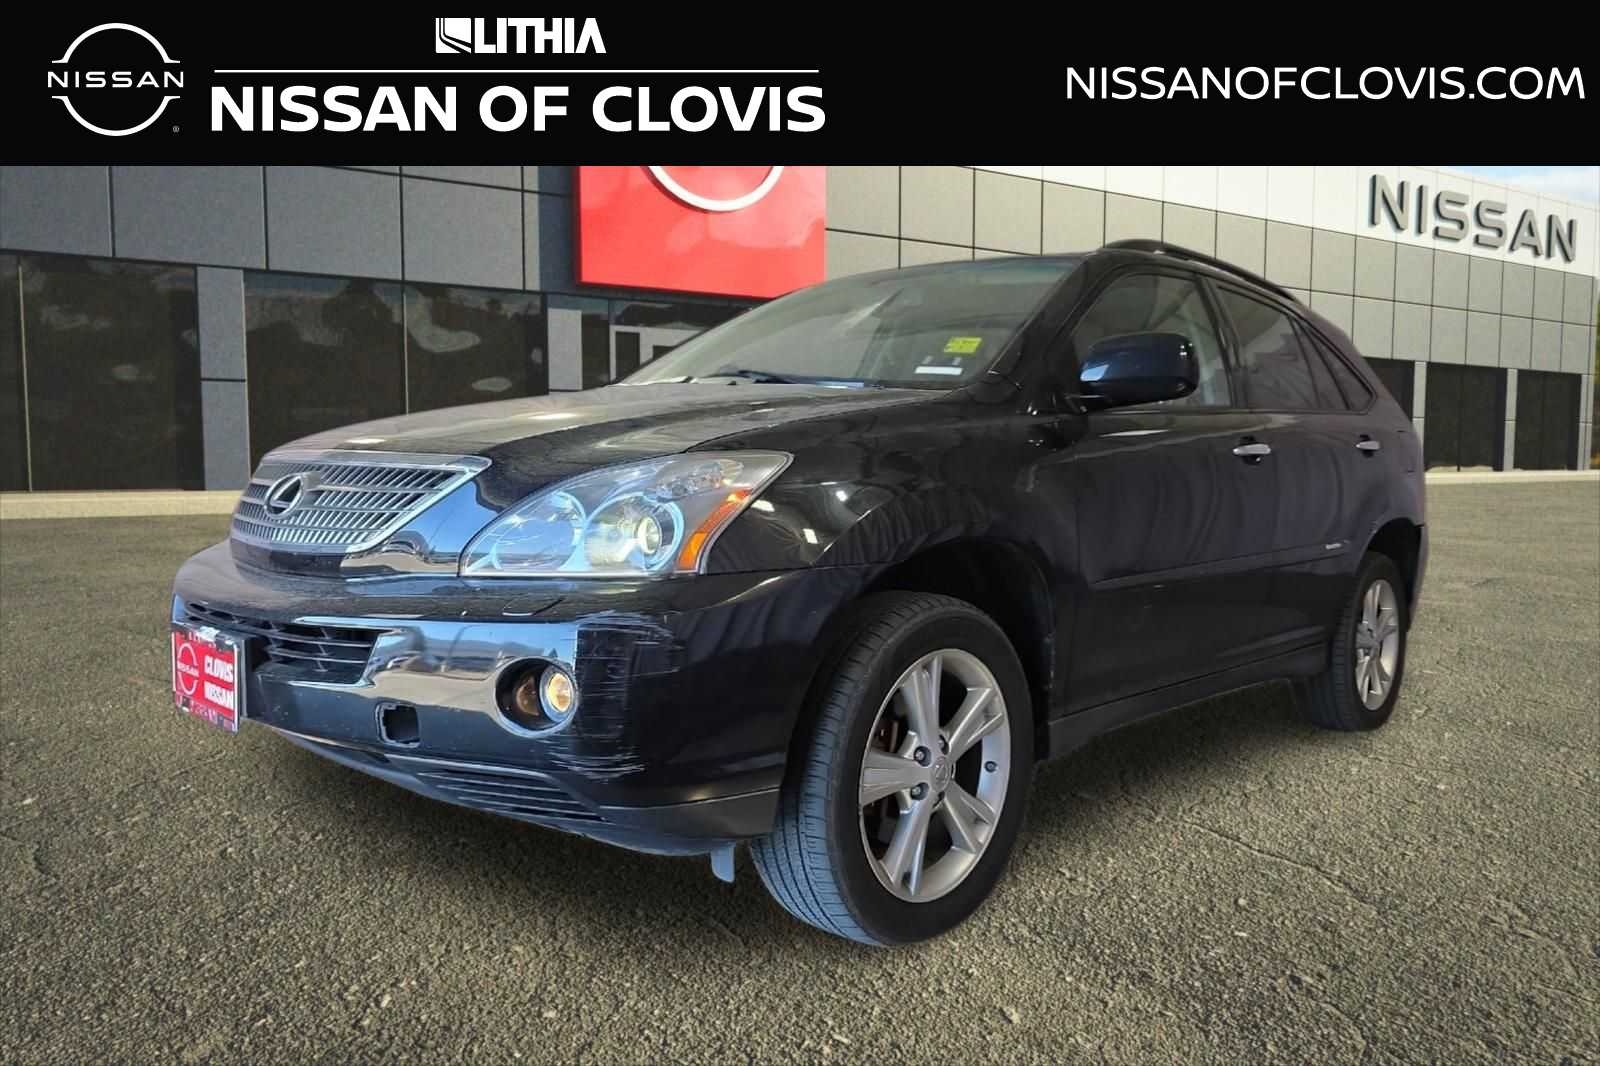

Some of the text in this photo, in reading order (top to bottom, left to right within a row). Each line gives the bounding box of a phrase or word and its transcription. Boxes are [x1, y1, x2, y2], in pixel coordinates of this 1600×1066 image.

[1369, 174, 1577, 262] NISSAN
[204, 655, 234, 683] CLOVIS
[204, 680, 234, 710] NISSAN
